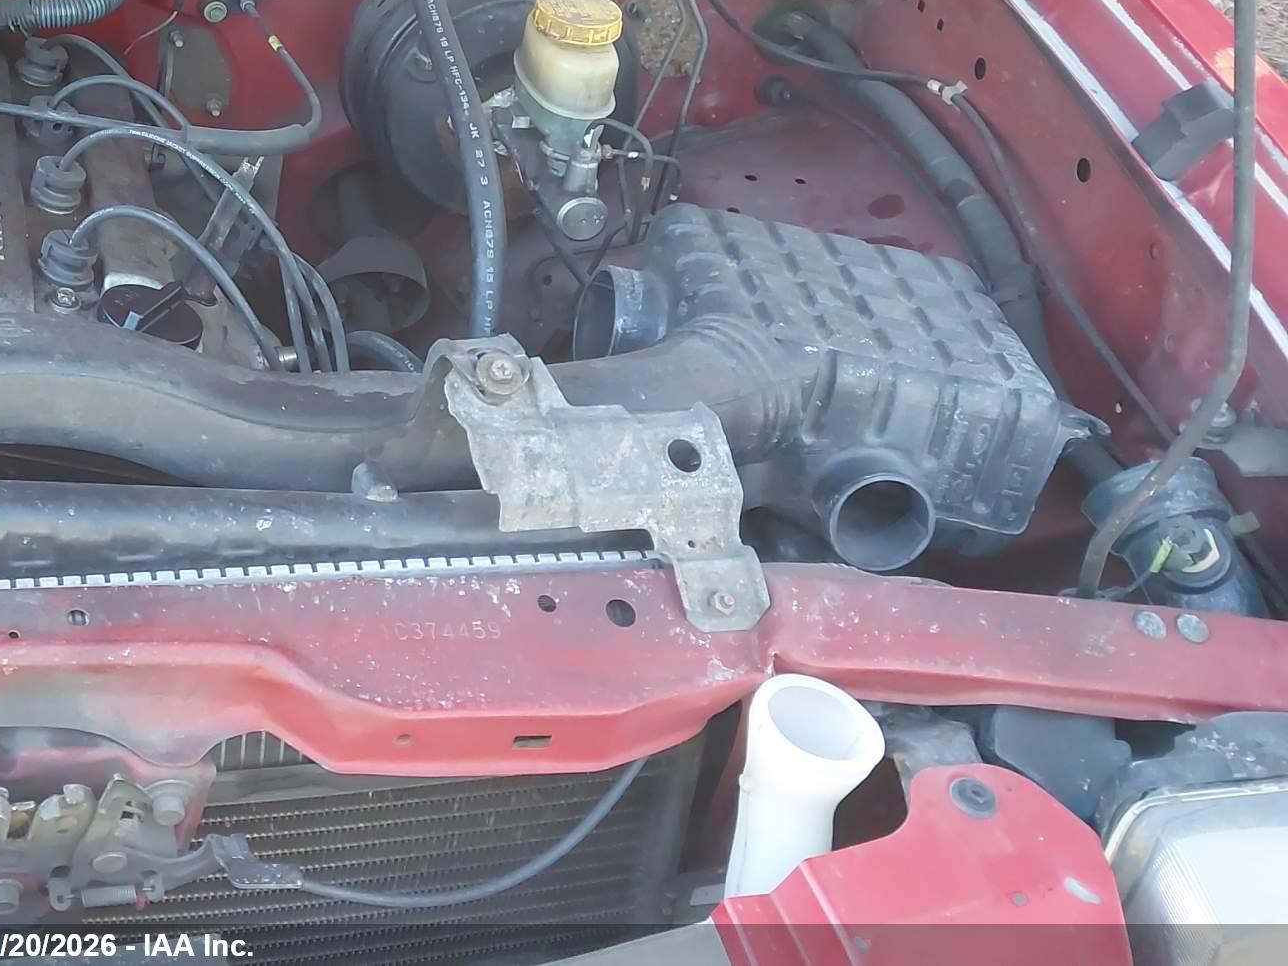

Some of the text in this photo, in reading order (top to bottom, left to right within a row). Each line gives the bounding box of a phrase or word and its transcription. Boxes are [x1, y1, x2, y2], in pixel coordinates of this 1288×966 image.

[443, 50, 456, 62] LP
[469, 122, 480, 139] JK
[475, 149, 486, 168] 27
[480, 175, 489, 186] 3
[486, 290, 495, 309] LP
